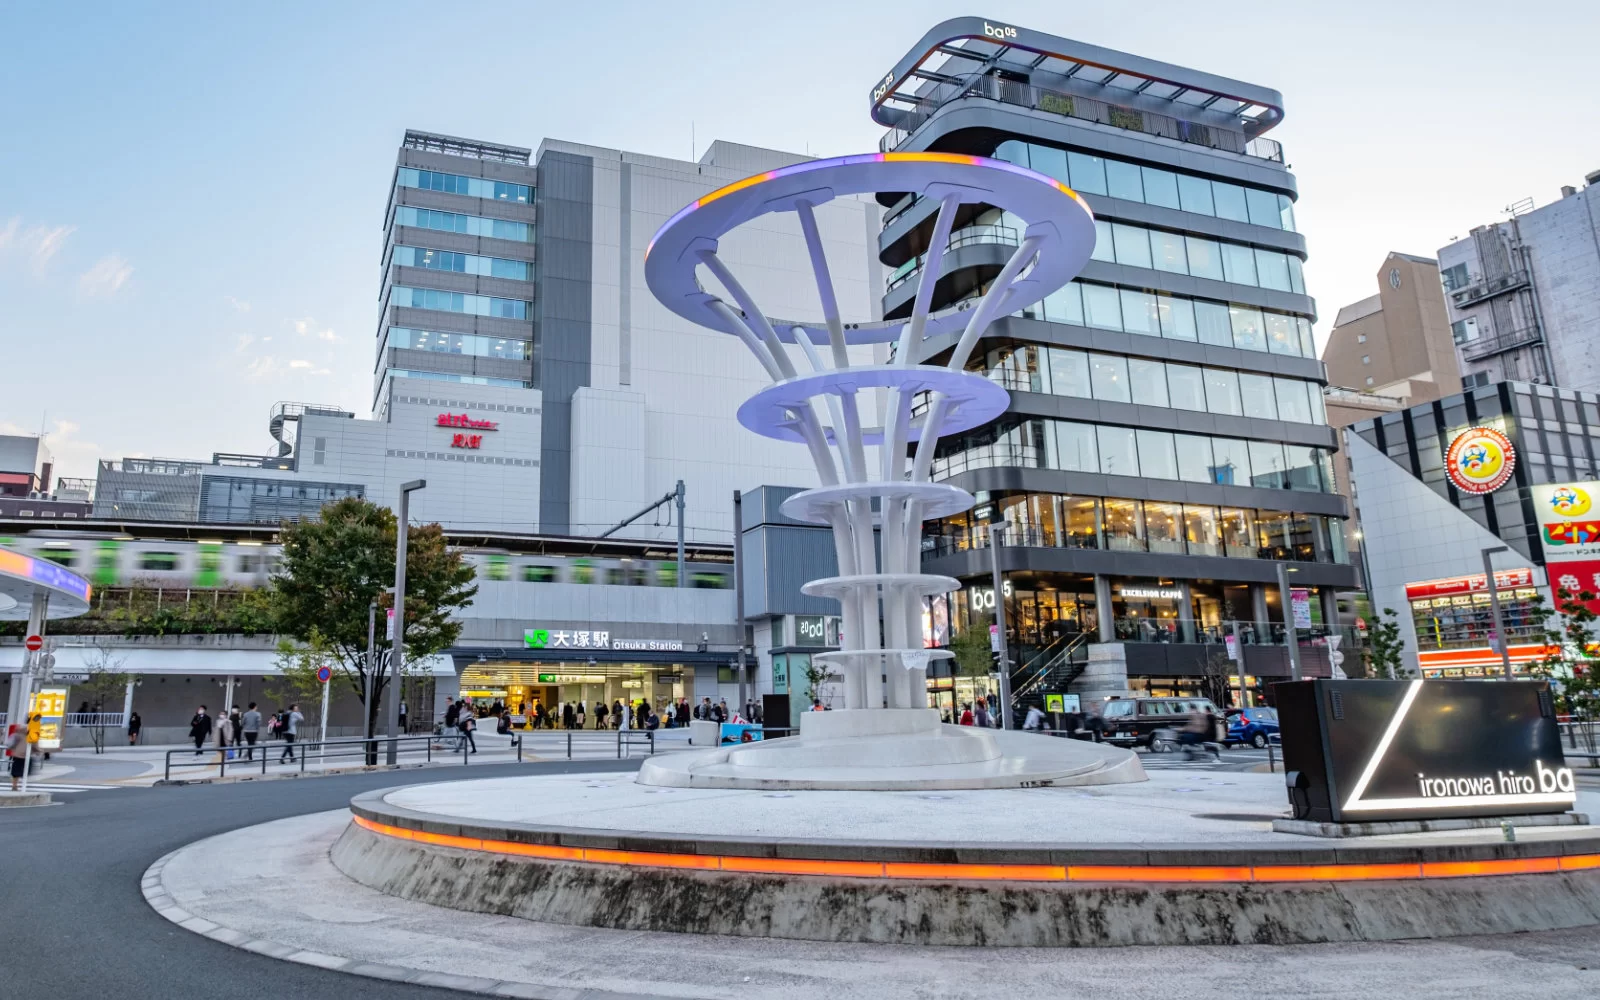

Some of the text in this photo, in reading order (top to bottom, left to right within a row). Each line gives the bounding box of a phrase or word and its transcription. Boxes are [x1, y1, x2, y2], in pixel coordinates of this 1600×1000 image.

[971, 579, 1012, 606] ba5
[1121, 588, 1159, 598] EXCELSIOR
[525, 629, 609, 648] JR 大塚駅
[649, 641, 683, 651] Station
[1418, 759, 1575, 797] ironowa hiro ba
